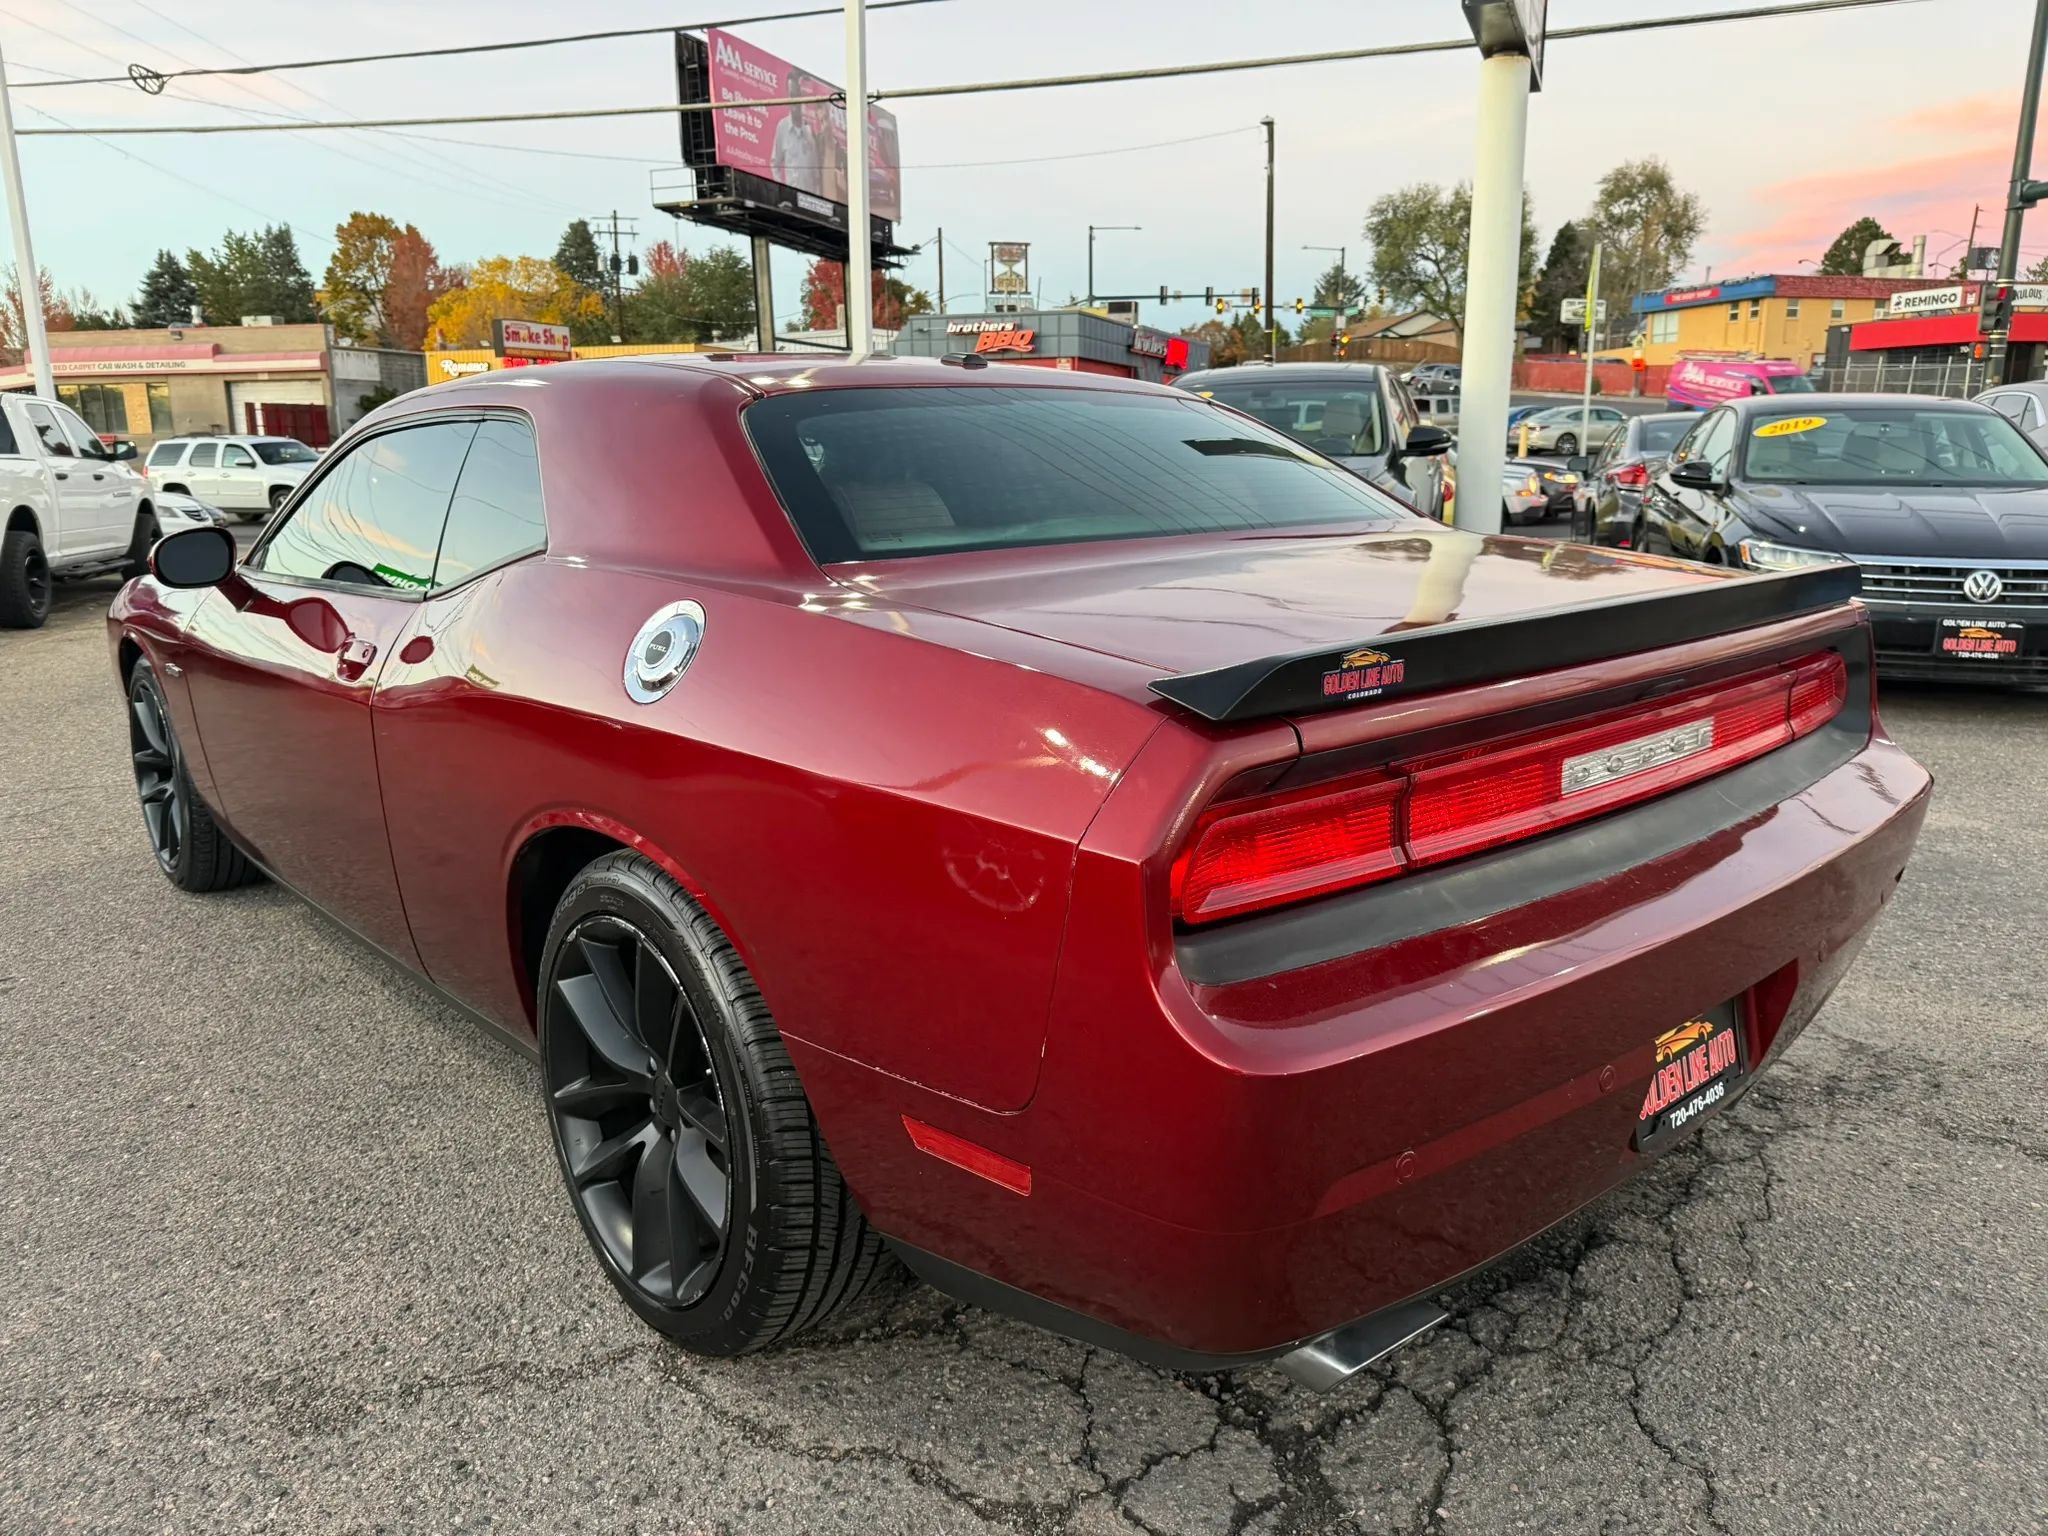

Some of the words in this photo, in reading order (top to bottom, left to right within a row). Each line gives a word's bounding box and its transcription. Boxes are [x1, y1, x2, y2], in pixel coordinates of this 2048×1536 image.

[716, 37, 743, 73] AAA
[743, 62, 778, 88] SERVICE
[1904, 292, 1958, 309] REMINGO
[946, 321, 1015, 334] brothers
[504, 325, 542, 345] Smoke
[543, 327, 569, 350] Shop
[975, 329, 1036, 353] BBQ
[69, 363, 96, 371] CARPET
[97, 362, 113, 370] CAR
[113, 362, 137, 370] WASH
[145, 360, 186, 369] DETAILING
[441, 359, 489, 377] Romance
[1769, 418, 1813, 434] 2019
[1971, 619, 1987, 628] LINE
[1987, 620, 2006, 628] AUTO
[649, 643, 667, 653] FUEL
[1943, 638, 1976, 651] GOLDEN
[1975, 638, 1994, 652] LINE
[1994, 639, 2017, 652] AUTO
[1324, 671, 1359, 695] GOLDEN
[1360, 666, 1380, 689] LINE
[1381, 663, 1404, 684] AUTO
[1347, 687, 1382, 699] COLORADO
[1682, 1043, 1710, 1092] LINE
[1708, 1027, 1736, 1077] AUTO
[1669, 1081, 1725, 1129] 720-476-4036
